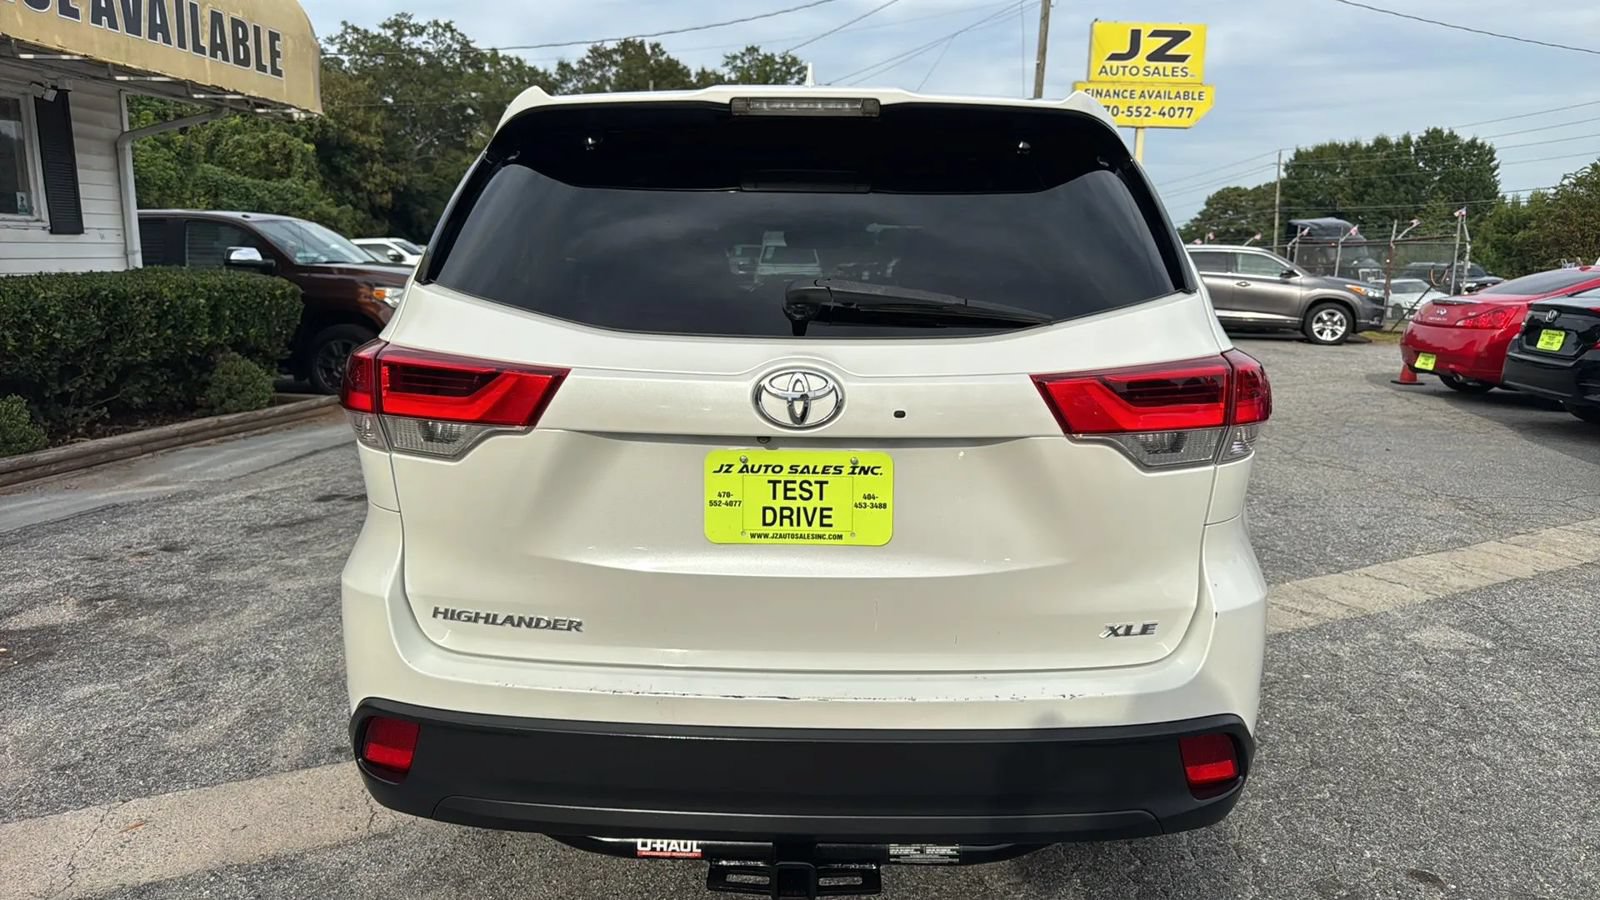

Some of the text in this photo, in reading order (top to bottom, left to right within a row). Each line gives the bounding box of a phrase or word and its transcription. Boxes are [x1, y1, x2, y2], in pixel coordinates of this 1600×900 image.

[89, 0, 284, 79] AVAILABLE
[1105, 28, 1192, 63] JZ
[1098, 65, 1140, 77] AUTO
[1143, 66, 1189, 78] SALES
[1138, 90, 1205, 101] AVAILABLE
[712, 463, 883, 476] JZ AUTO SALES INC.
[767, 479, 829, 501] TEST
[761, 506, 833, 528] DRIVE
[749, 532, 843, 541] WWW.JZAUTOSALESINC.COM
[432, 606, 583, 633] HIGHLANDER
[1099, 621, 1159, 639] XLE
[636, 839, 702, 853] U-HAUL
